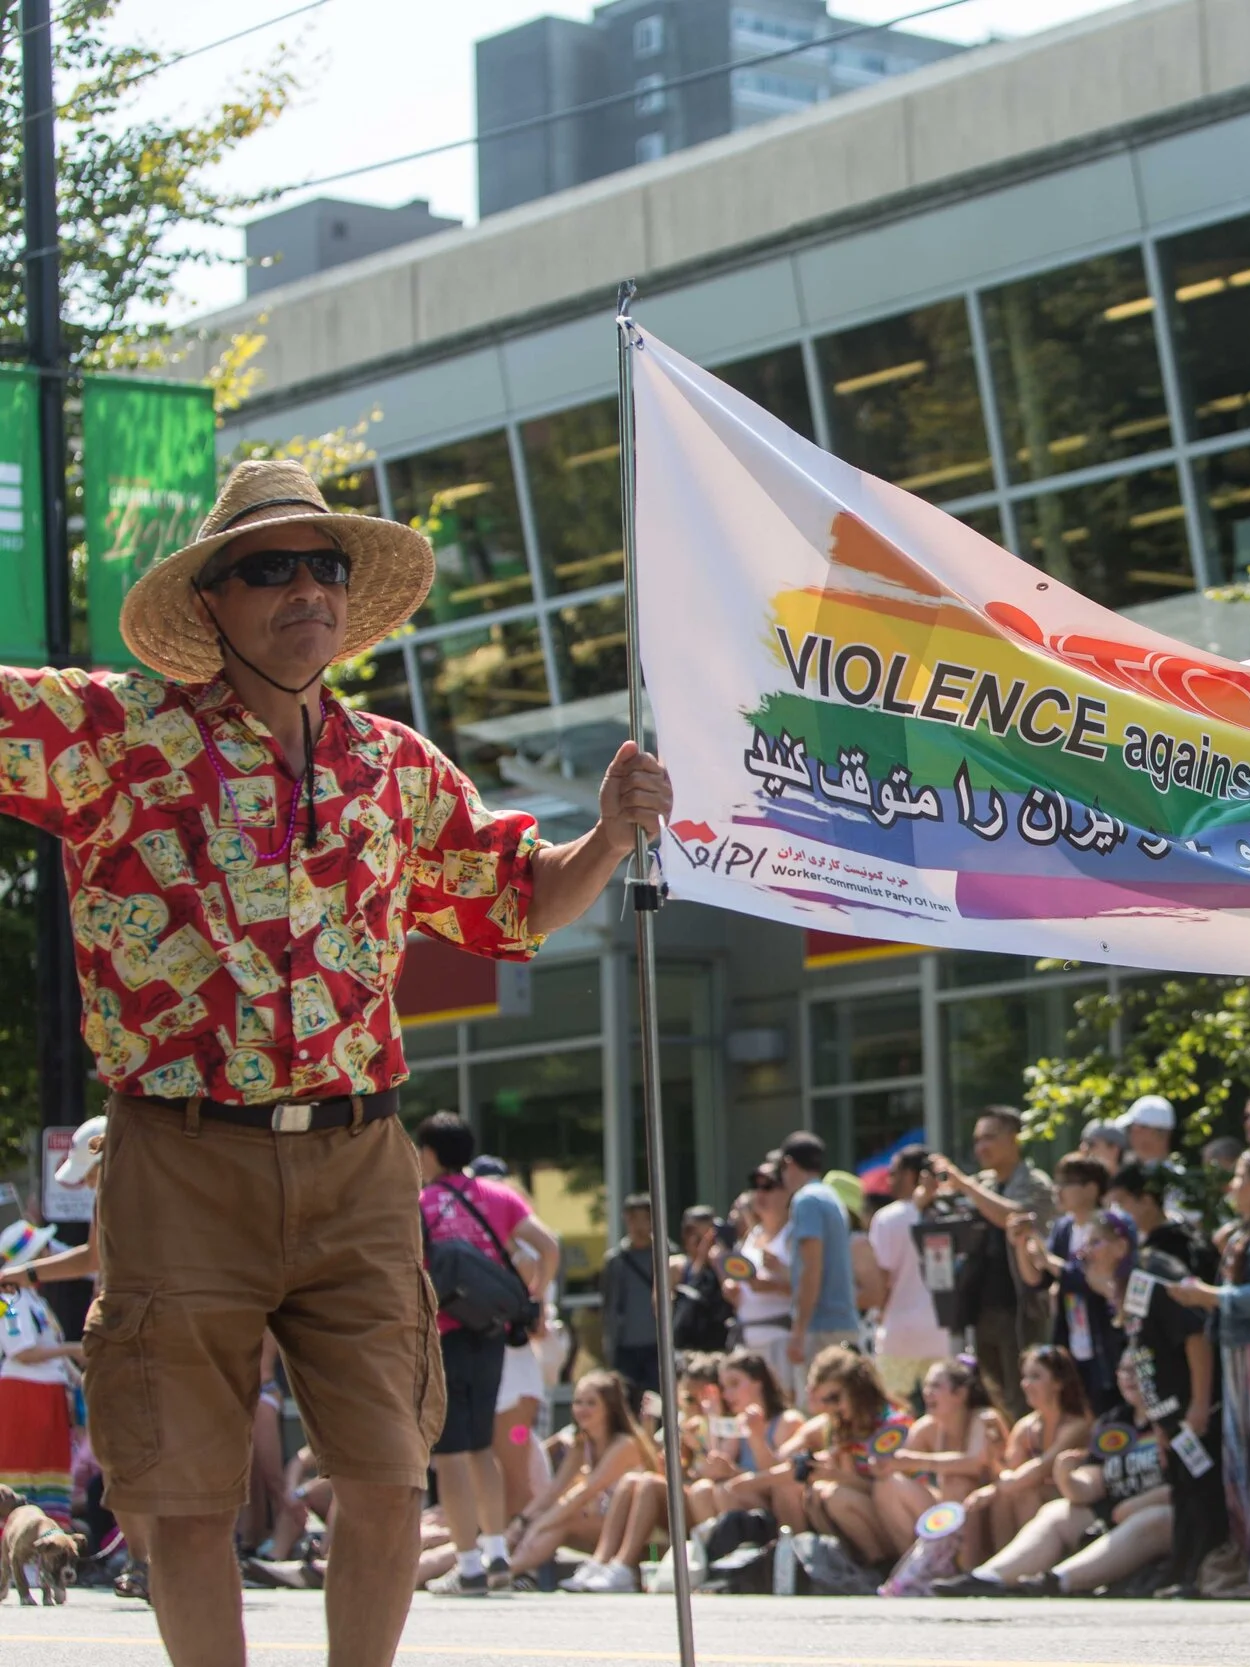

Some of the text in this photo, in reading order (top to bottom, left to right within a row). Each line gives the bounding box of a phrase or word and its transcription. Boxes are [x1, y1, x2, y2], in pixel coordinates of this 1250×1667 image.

[775, 626, 1109, 761] VIOLENCE
[745, 726, 811, 798] کنید
[820, 746, 944, 828] متوقف
[954, 759, 1007, 841] را
[771, 863, 952, 913] Worker-communist Party Of Iran
[777, 846, 806, 861] ایران
